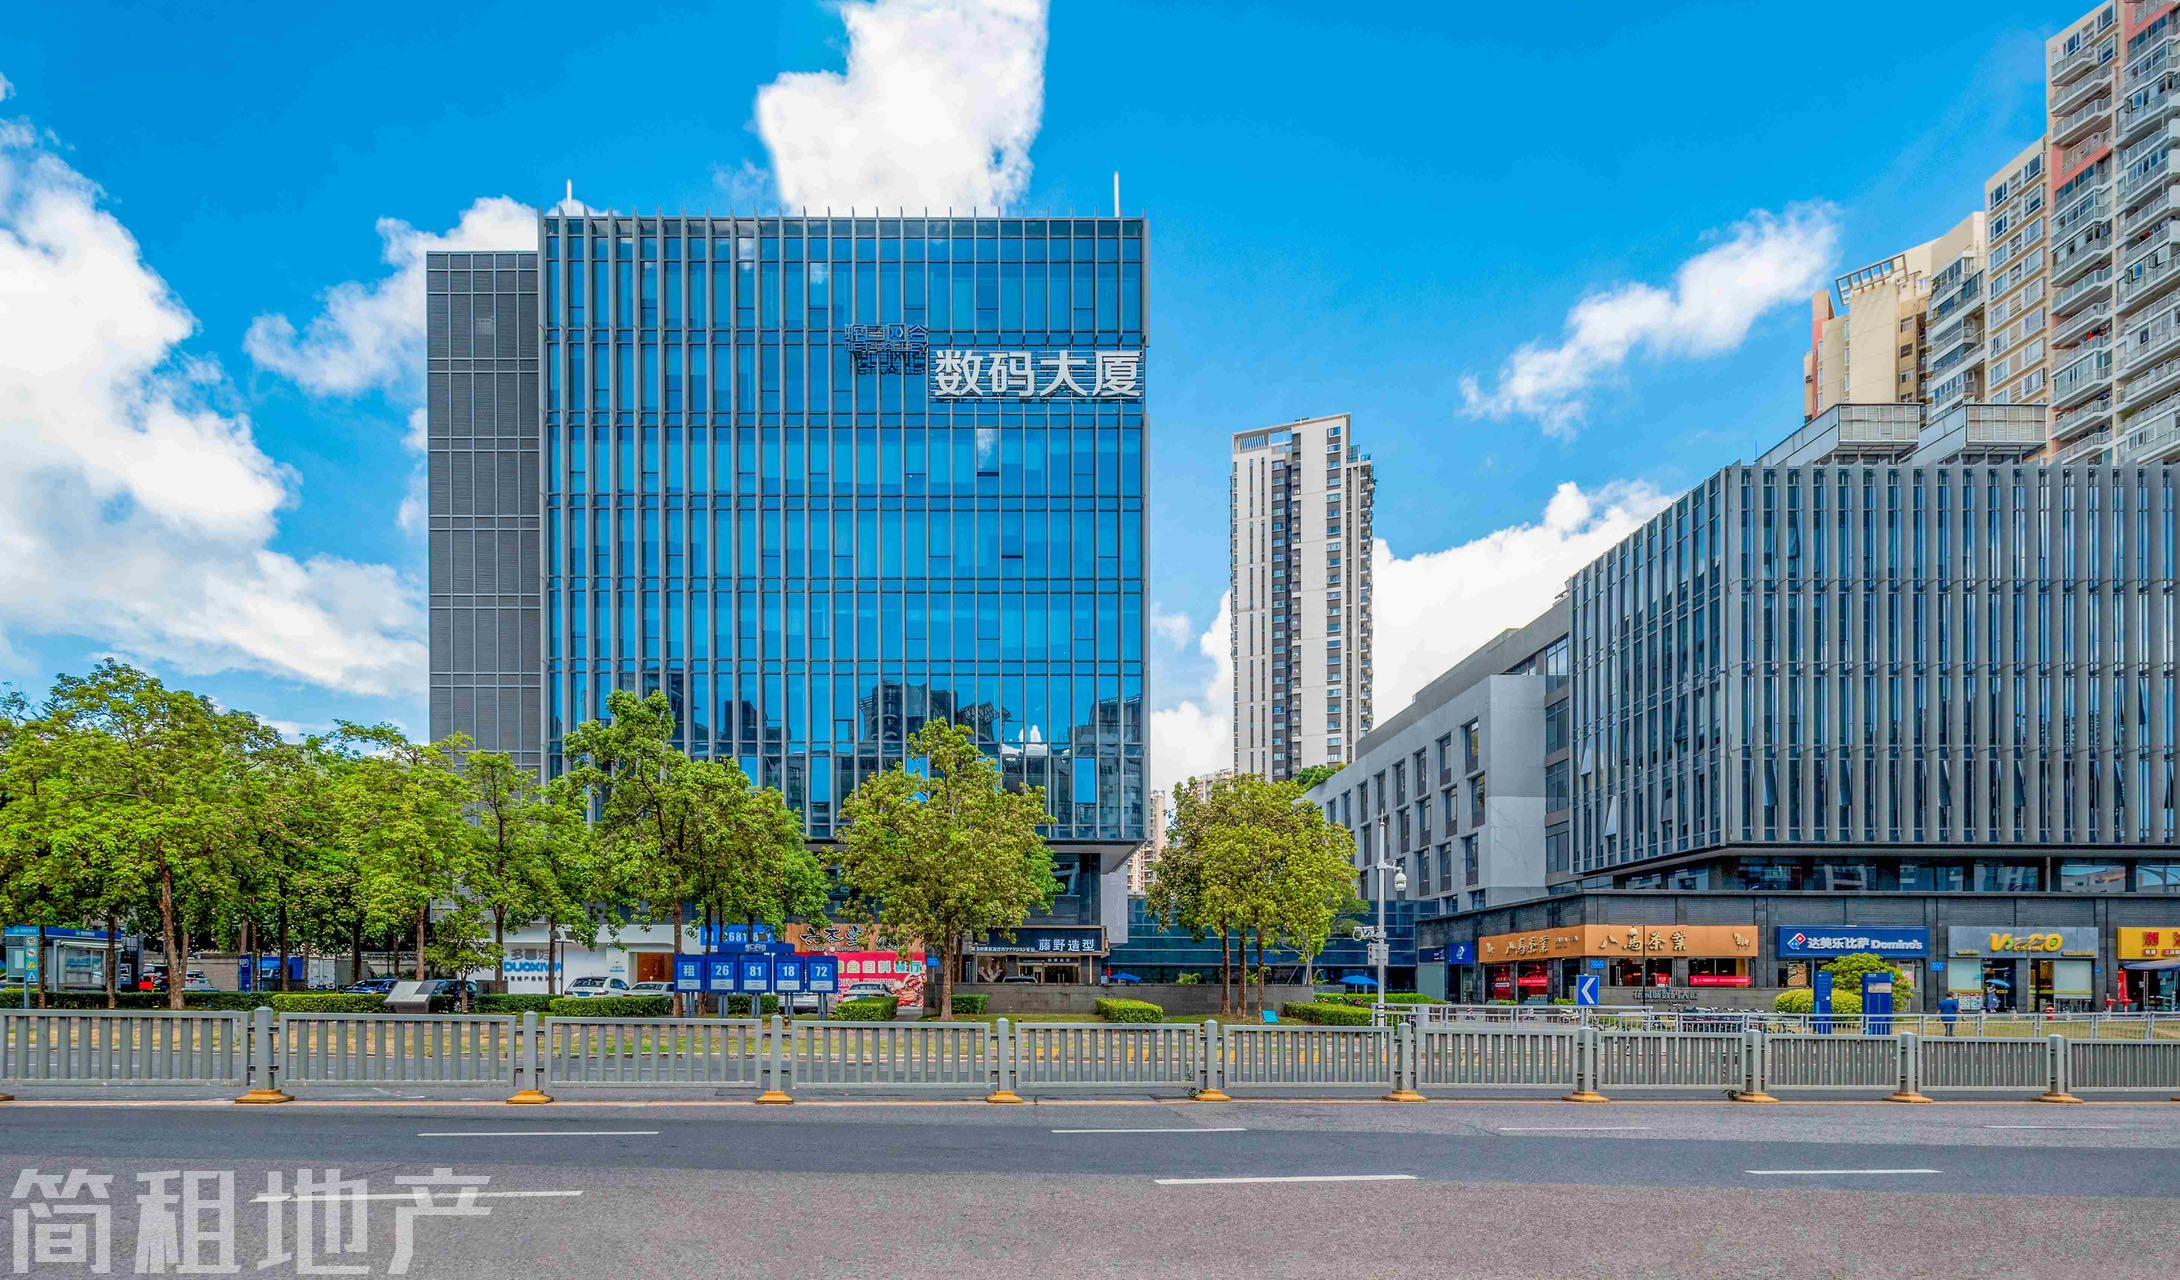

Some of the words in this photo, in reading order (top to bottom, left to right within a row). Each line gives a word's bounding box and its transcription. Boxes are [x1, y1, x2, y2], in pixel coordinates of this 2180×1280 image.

[935, 350, 1140, 396] 数码大厦
[1038, 939, 1095, 952] 藤野造型
[1871, 939, 1923, 950] Domino's
[683, 965, 695, 976] 租
[715, 965, 729, 976] 26
[749, 965, 762, 976] 81
[783, 965, 795, 976] 18
[815, 966, 828, 976] 72
